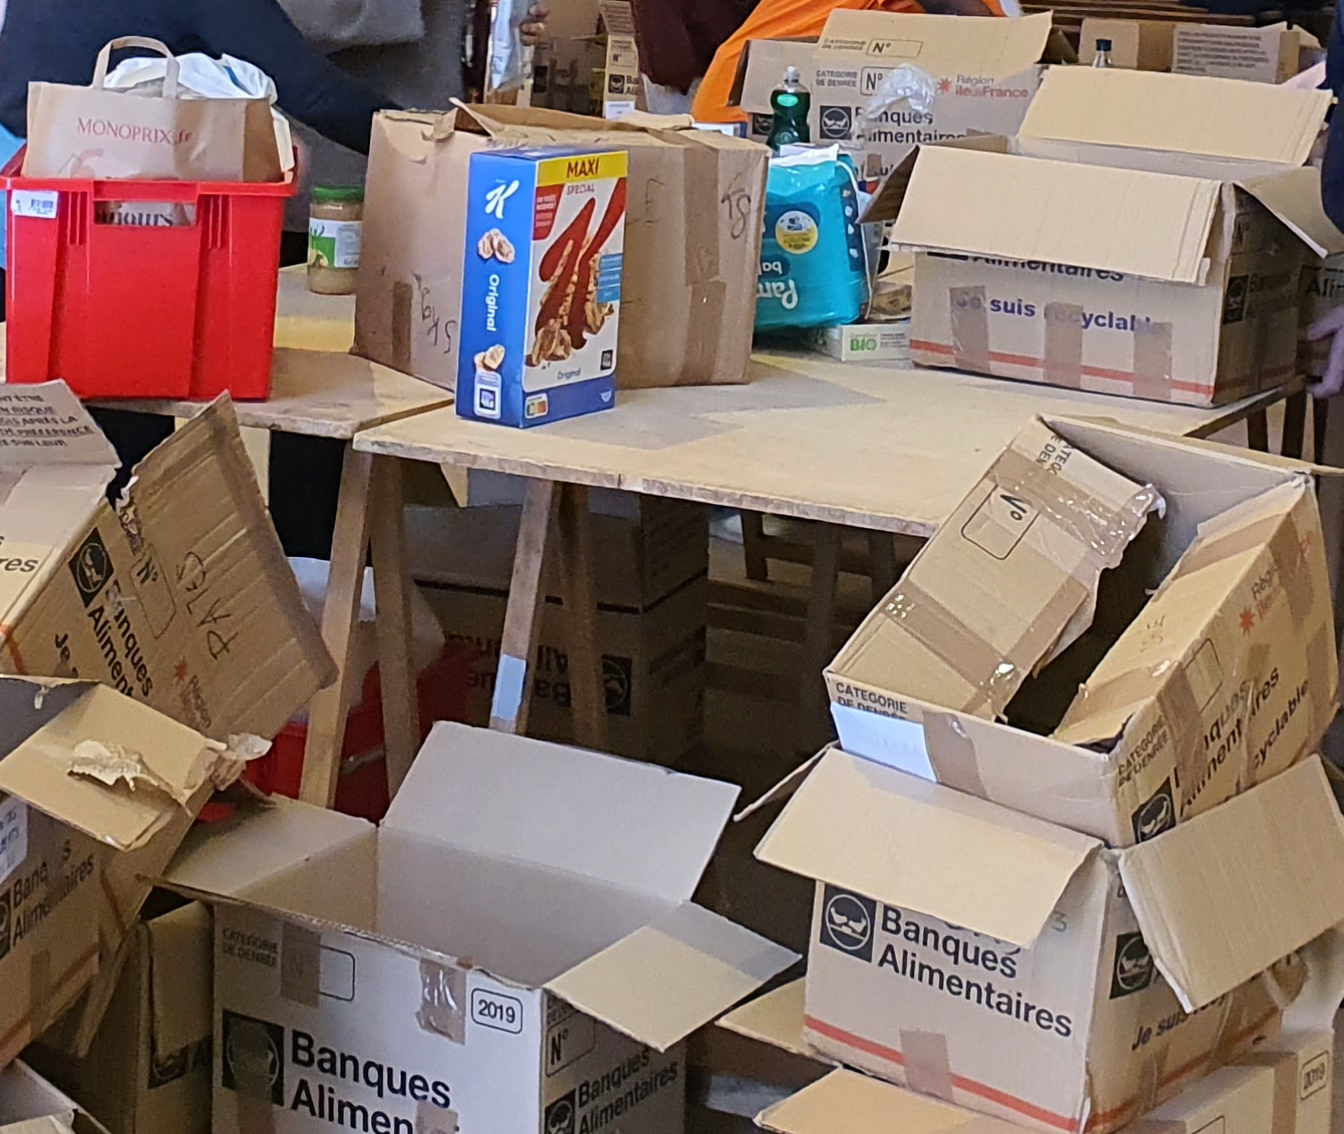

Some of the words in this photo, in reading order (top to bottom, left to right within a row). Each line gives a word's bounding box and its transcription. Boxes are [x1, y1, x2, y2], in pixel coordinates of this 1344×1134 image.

[872, 42, 892, 54] N°
[866, 72, 883, 89] N°
[957, 74, 994, 86] Région
[566, 159, 599, 179] MAXI
[484, 180, 520, 219] K
[486, 274, 501, 331] Original
[990, 298, 1036, 318] suis
[850, 339, 877, 351] BIO
[136, 557, 159, 585] N°
[55, 633, 71, 660] Je
[88, 605, 135, 697] Aliment
[835, 681, 909, 714] CATEGORIE
[882, 905, 1018, 979] Banques
[878, 944, 1073, 1038] Alimentaires
[478, 998, 516, 1024] 2019
[551, 1028, 569, 1065] N°
[1132, 1025, 1152, 1051] Je
[291, 1028, 451, 1109] Banques
[579, 1047, 650, 1108] Banques
[290, 1078, 416, 1134] Alimen
[579, 1061, 679, 1134] Alimentaires
